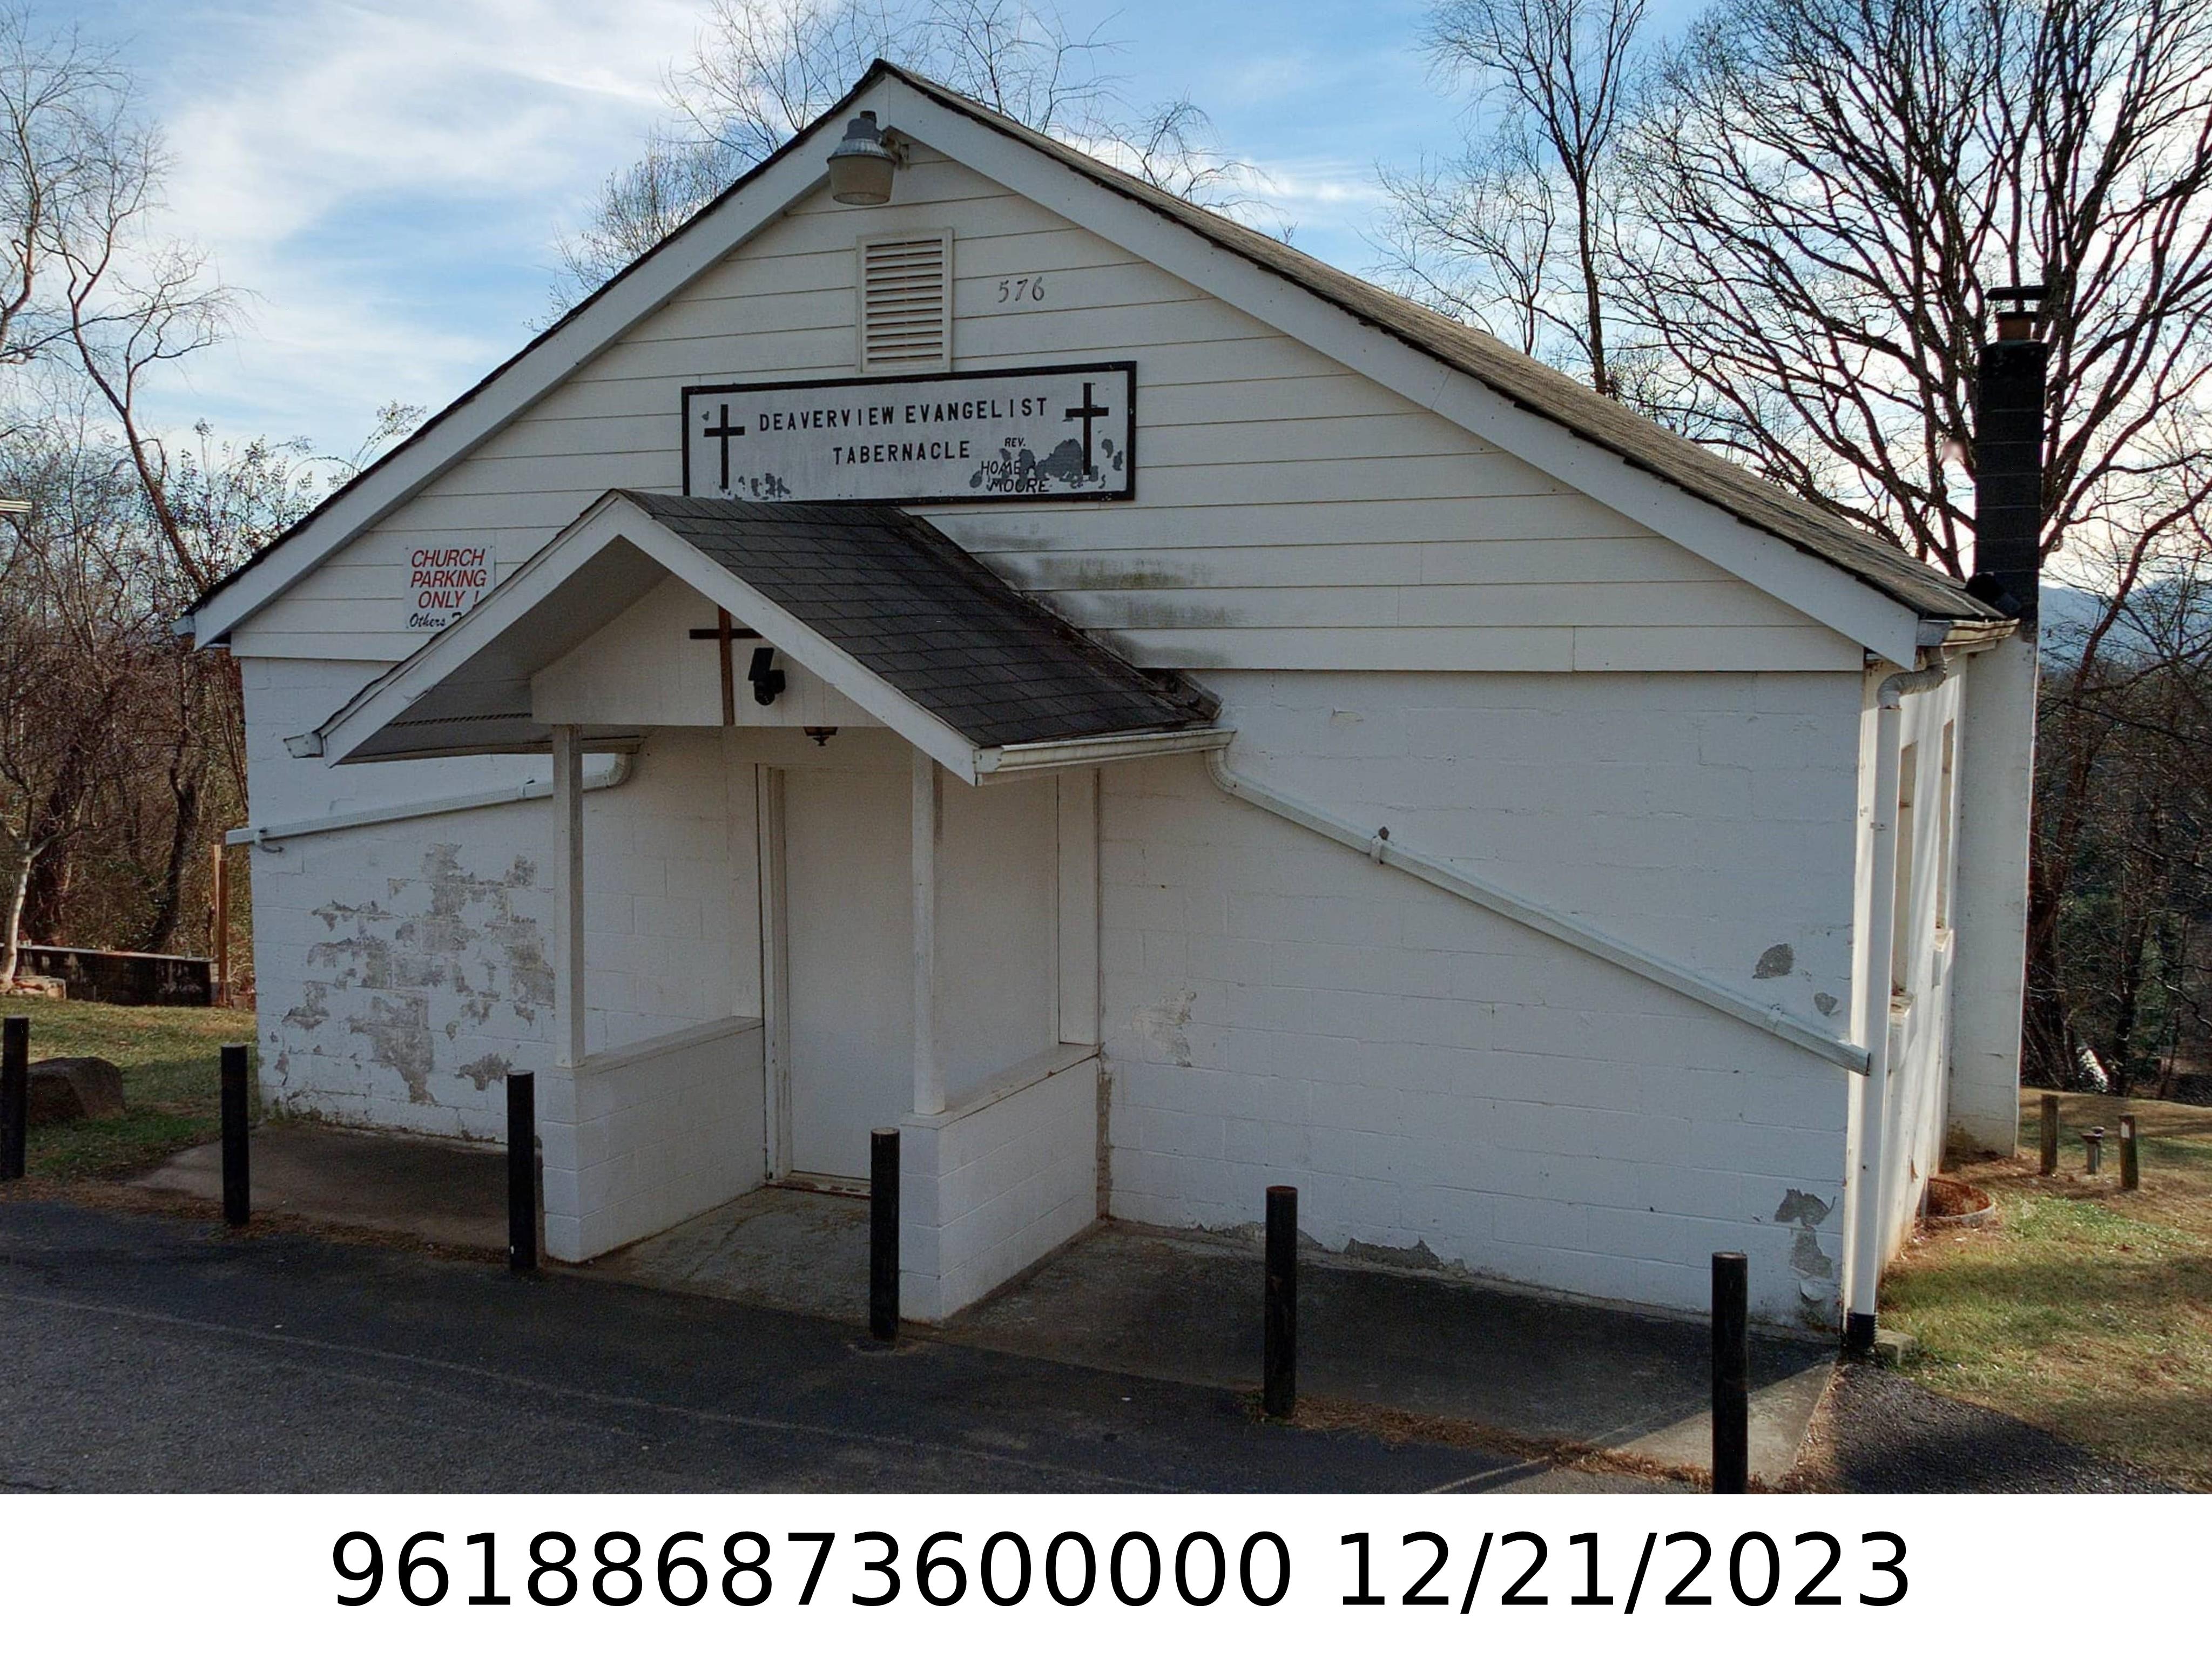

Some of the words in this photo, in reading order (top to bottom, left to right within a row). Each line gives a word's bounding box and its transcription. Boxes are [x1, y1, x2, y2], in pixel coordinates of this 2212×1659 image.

[999, 276, 1044, 303] 576
[759, 406, 894, 431] DEAVERVIEW
[905, 397, 1047, 423] EVANGELIST
[1004, 437, 1026, 447] REV.
[833, 440, 970, 465] TABERNACLE
[987, 477, 1050, 493] MOORE
[412, 548, 485, 567] CHURCH
[410, 569, 487, 588] PARKING
[409, 612, 446, 628] Others
